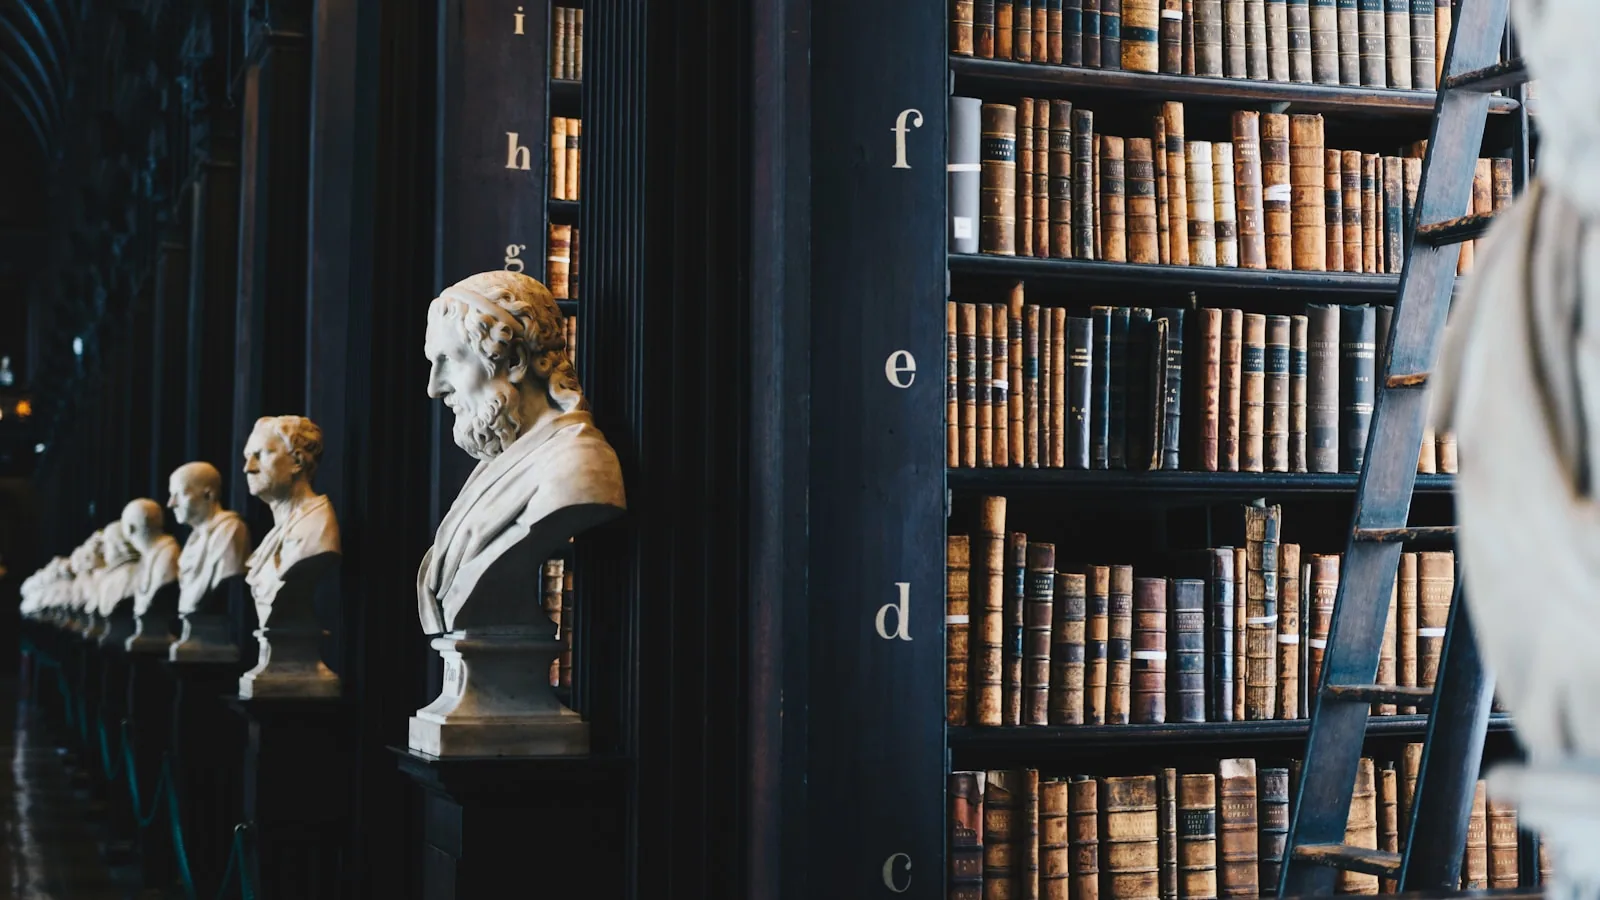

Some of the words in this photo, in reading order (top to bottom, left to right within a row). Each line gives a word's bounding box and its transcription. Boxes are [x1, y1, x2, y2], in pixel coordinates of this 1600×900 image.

[513, 6, 526, 35] i
[504, 132, 532, 171] h
[890, 108, 923, 169] f
[504, 243, 526, 273] g
[885, 349, 917, 388] e
[875, 582, 913, 641] d
[882, 852, 912, 893] c
